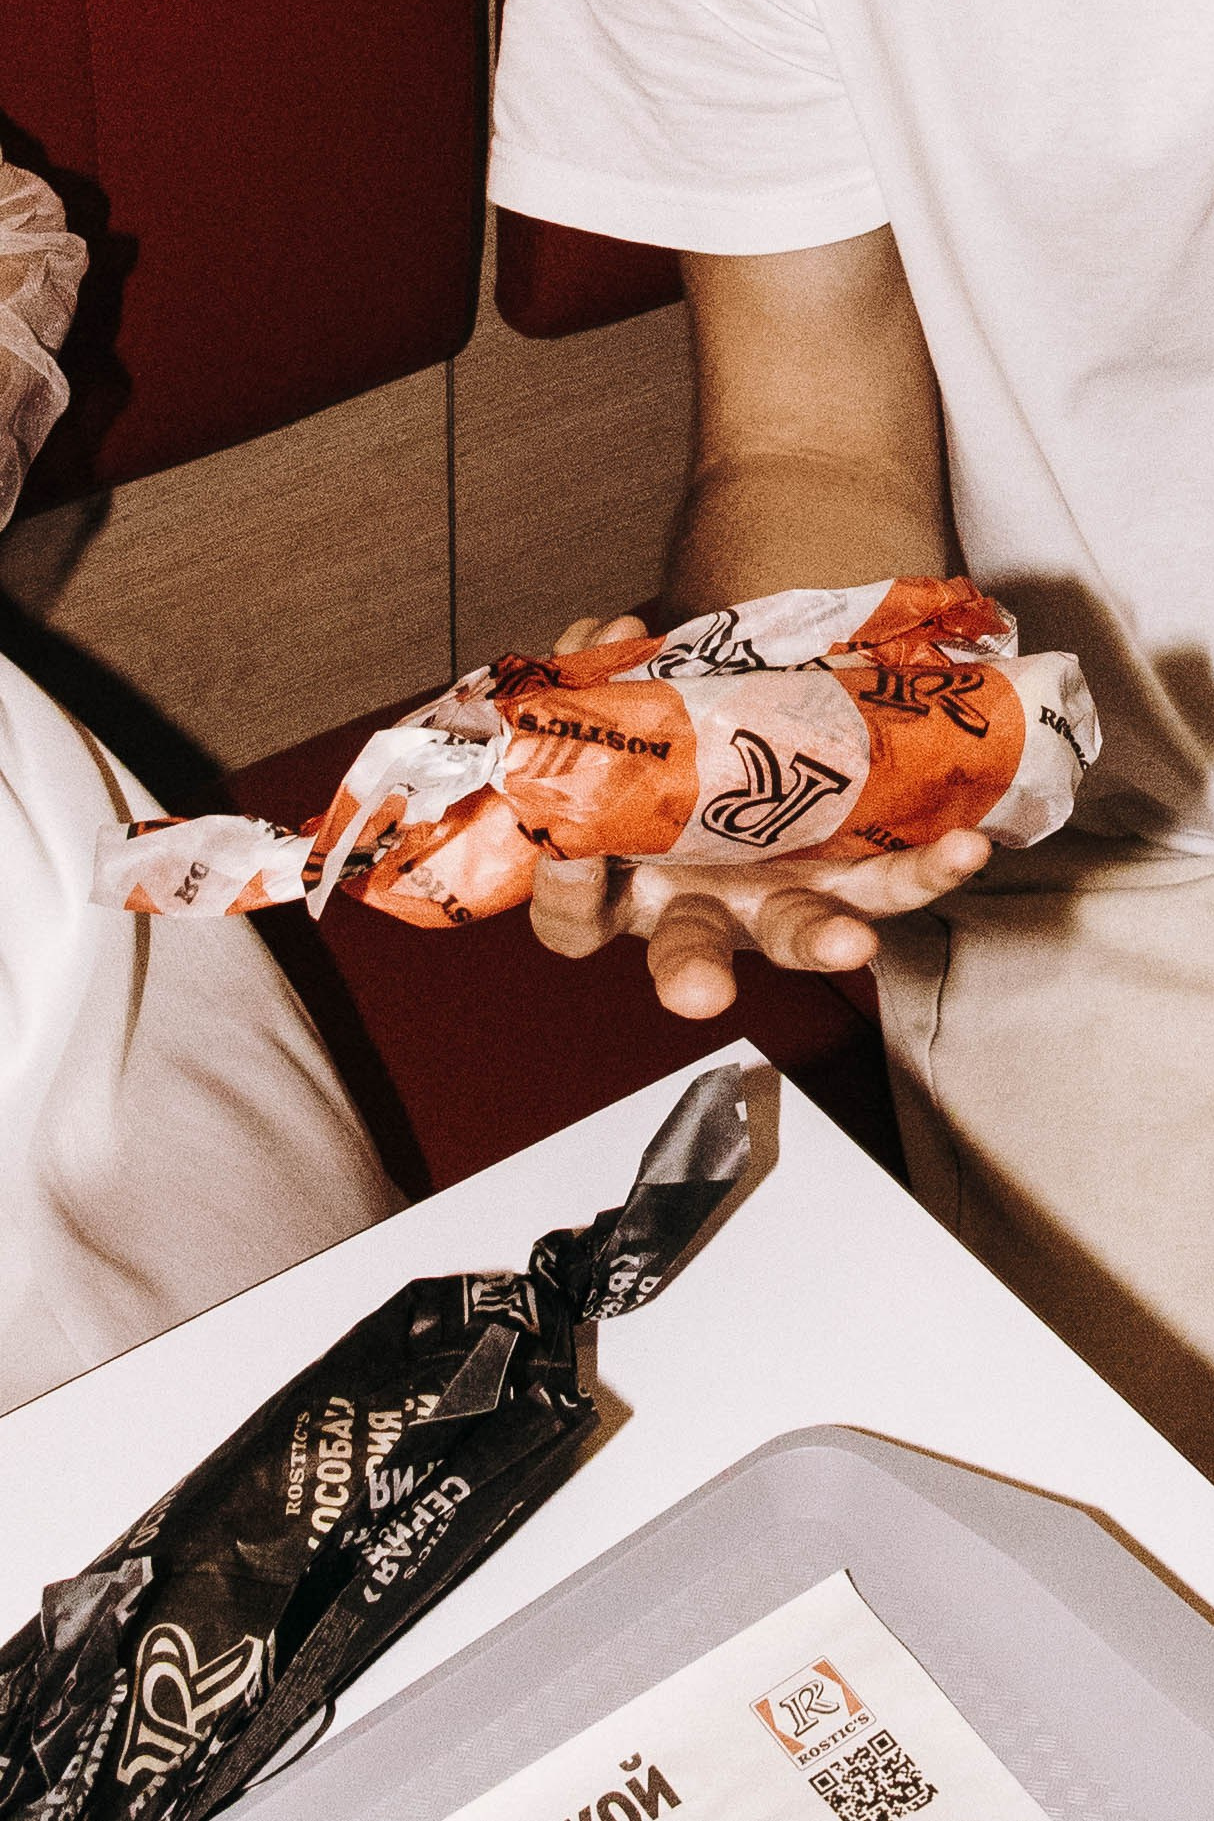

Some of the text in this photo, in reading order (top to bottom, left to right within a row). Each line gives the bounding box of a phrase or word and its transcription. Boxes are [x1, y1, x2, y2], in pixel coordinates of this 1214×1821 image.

[701, 728, 853, 848] R
[285, 1410, 311, 1516] ROSTIC'S
[117, 1623, 264, 1786] R
[779, 1679, 841, 1738] R
[797, 1712, 870, 1766] ROSTIC'S
